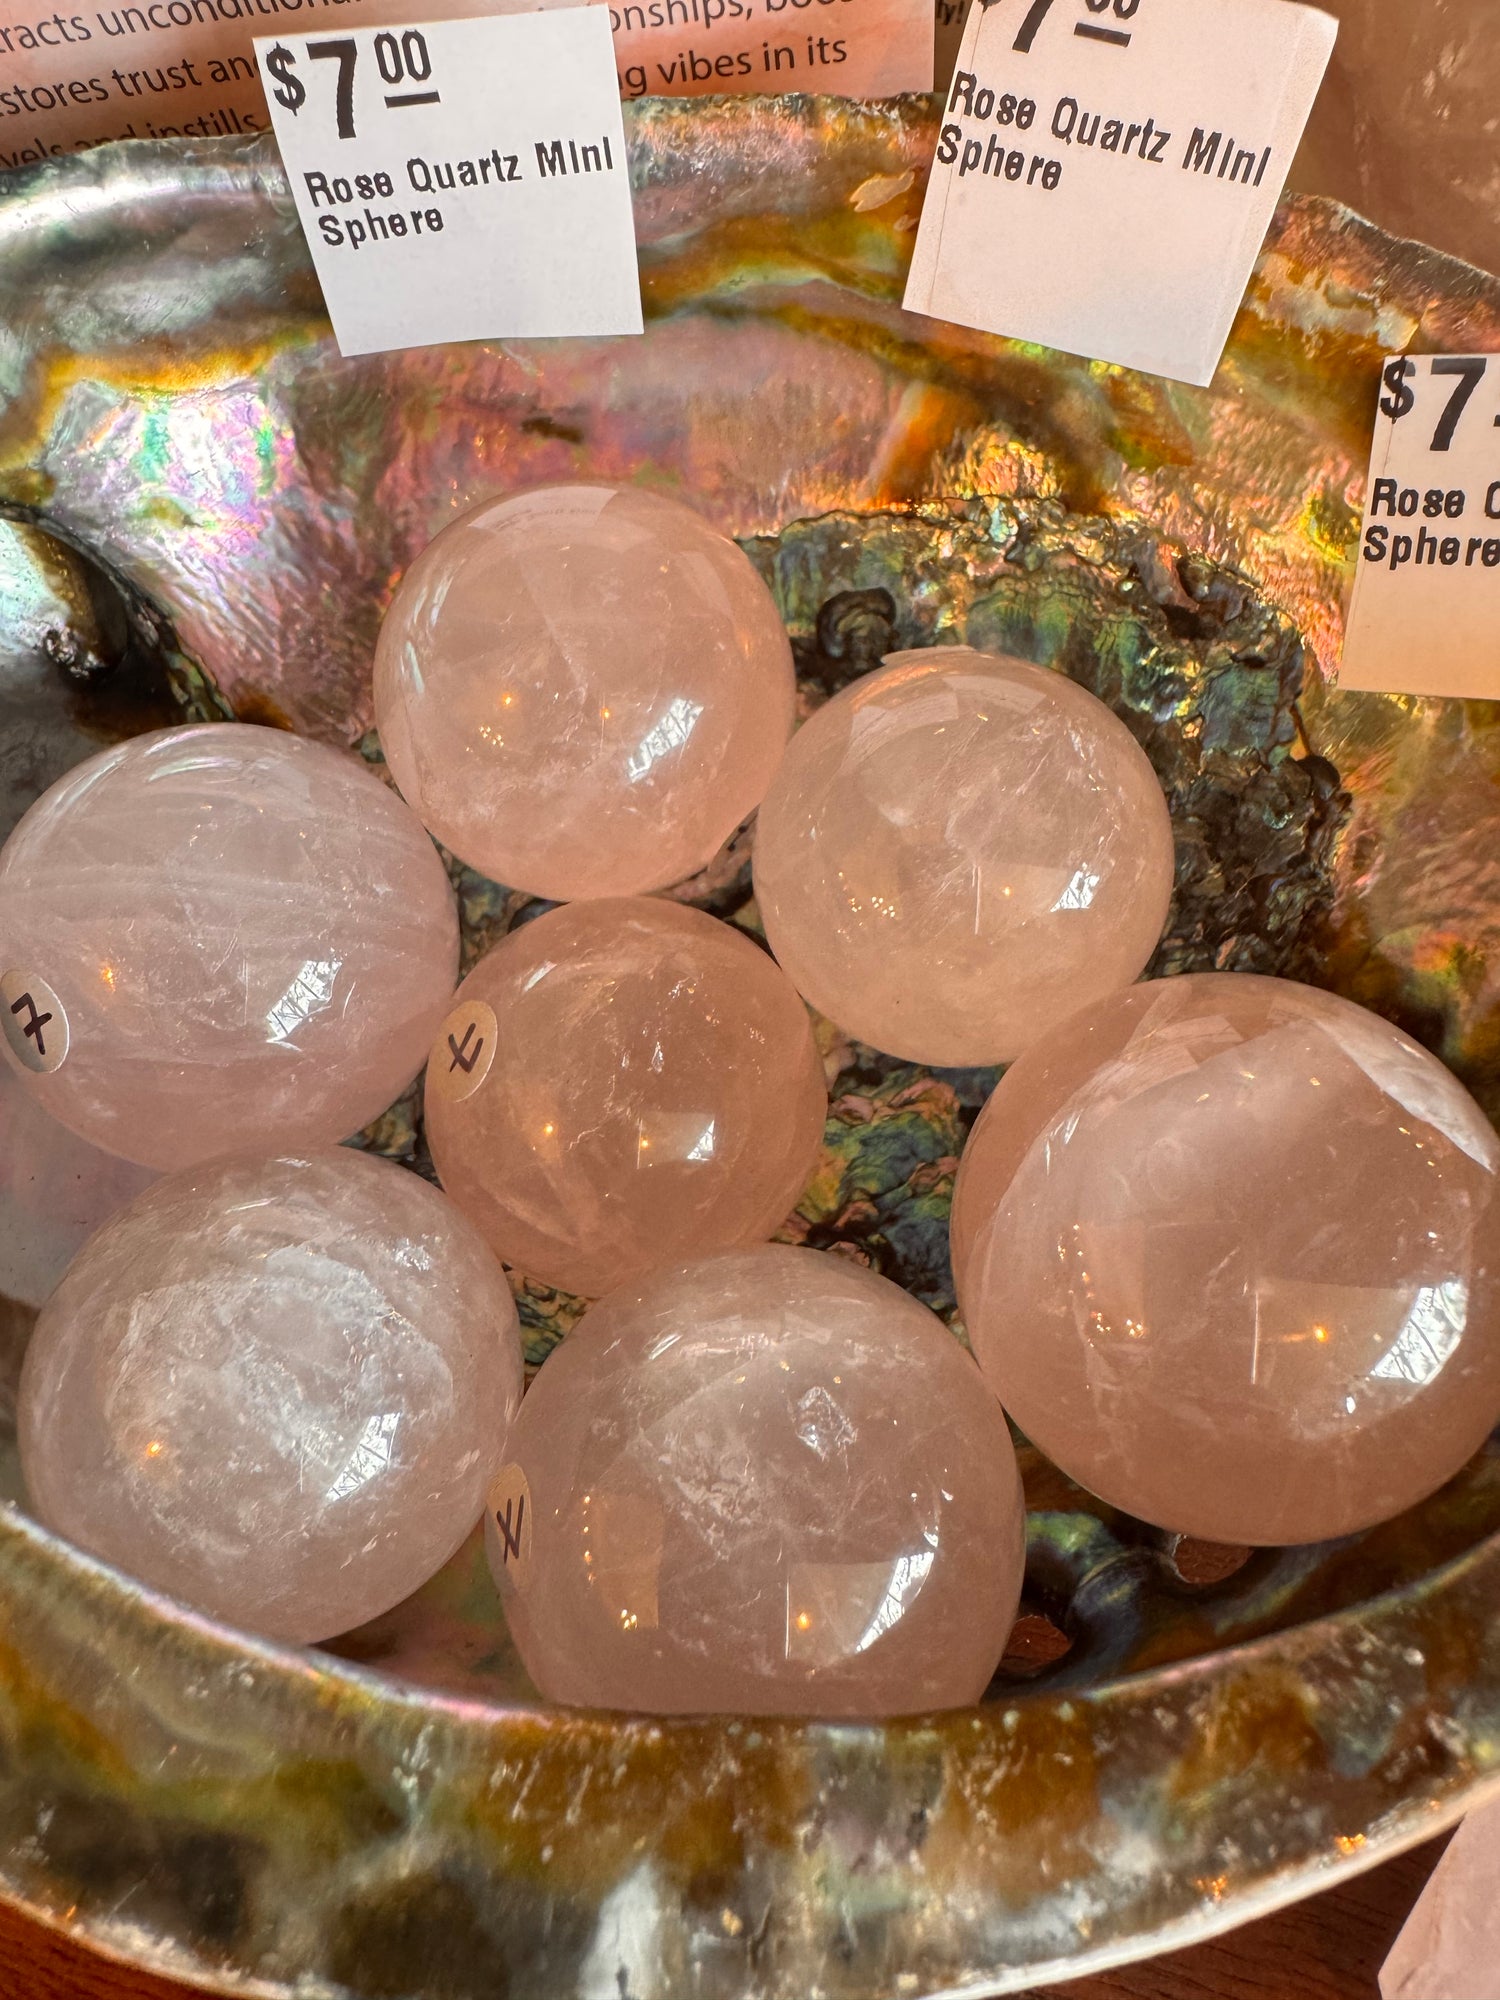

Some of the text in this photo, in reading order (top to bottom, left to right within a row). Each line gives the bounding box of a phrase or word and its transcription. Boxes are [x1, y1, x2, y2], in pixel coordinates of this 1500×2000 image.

[0, 14, 92, 52] racts
[0, 79, 109, 116] stores
[112, 59, 203, 97] trust
[207, 56, 259, 89] an
[657, 50, 752, 84] vibes
[763, 42, 795, 72] in
[807, 36, 848, 66] its
[948, 70, 1037, 131] Rose
[1051, 96, 1172, 163] Quartz
[303, 171, 395, 208] Rose
[406, 149, 522, 194] Quartz
[936, 124, 1063, 191] Sphere
[319, 208, 444, 250] Sphere
[1371, 477, 1466, 519] Rose
[1363, 525, 1500, 571] Sphere
[10, 992, 53, 1056] 7
